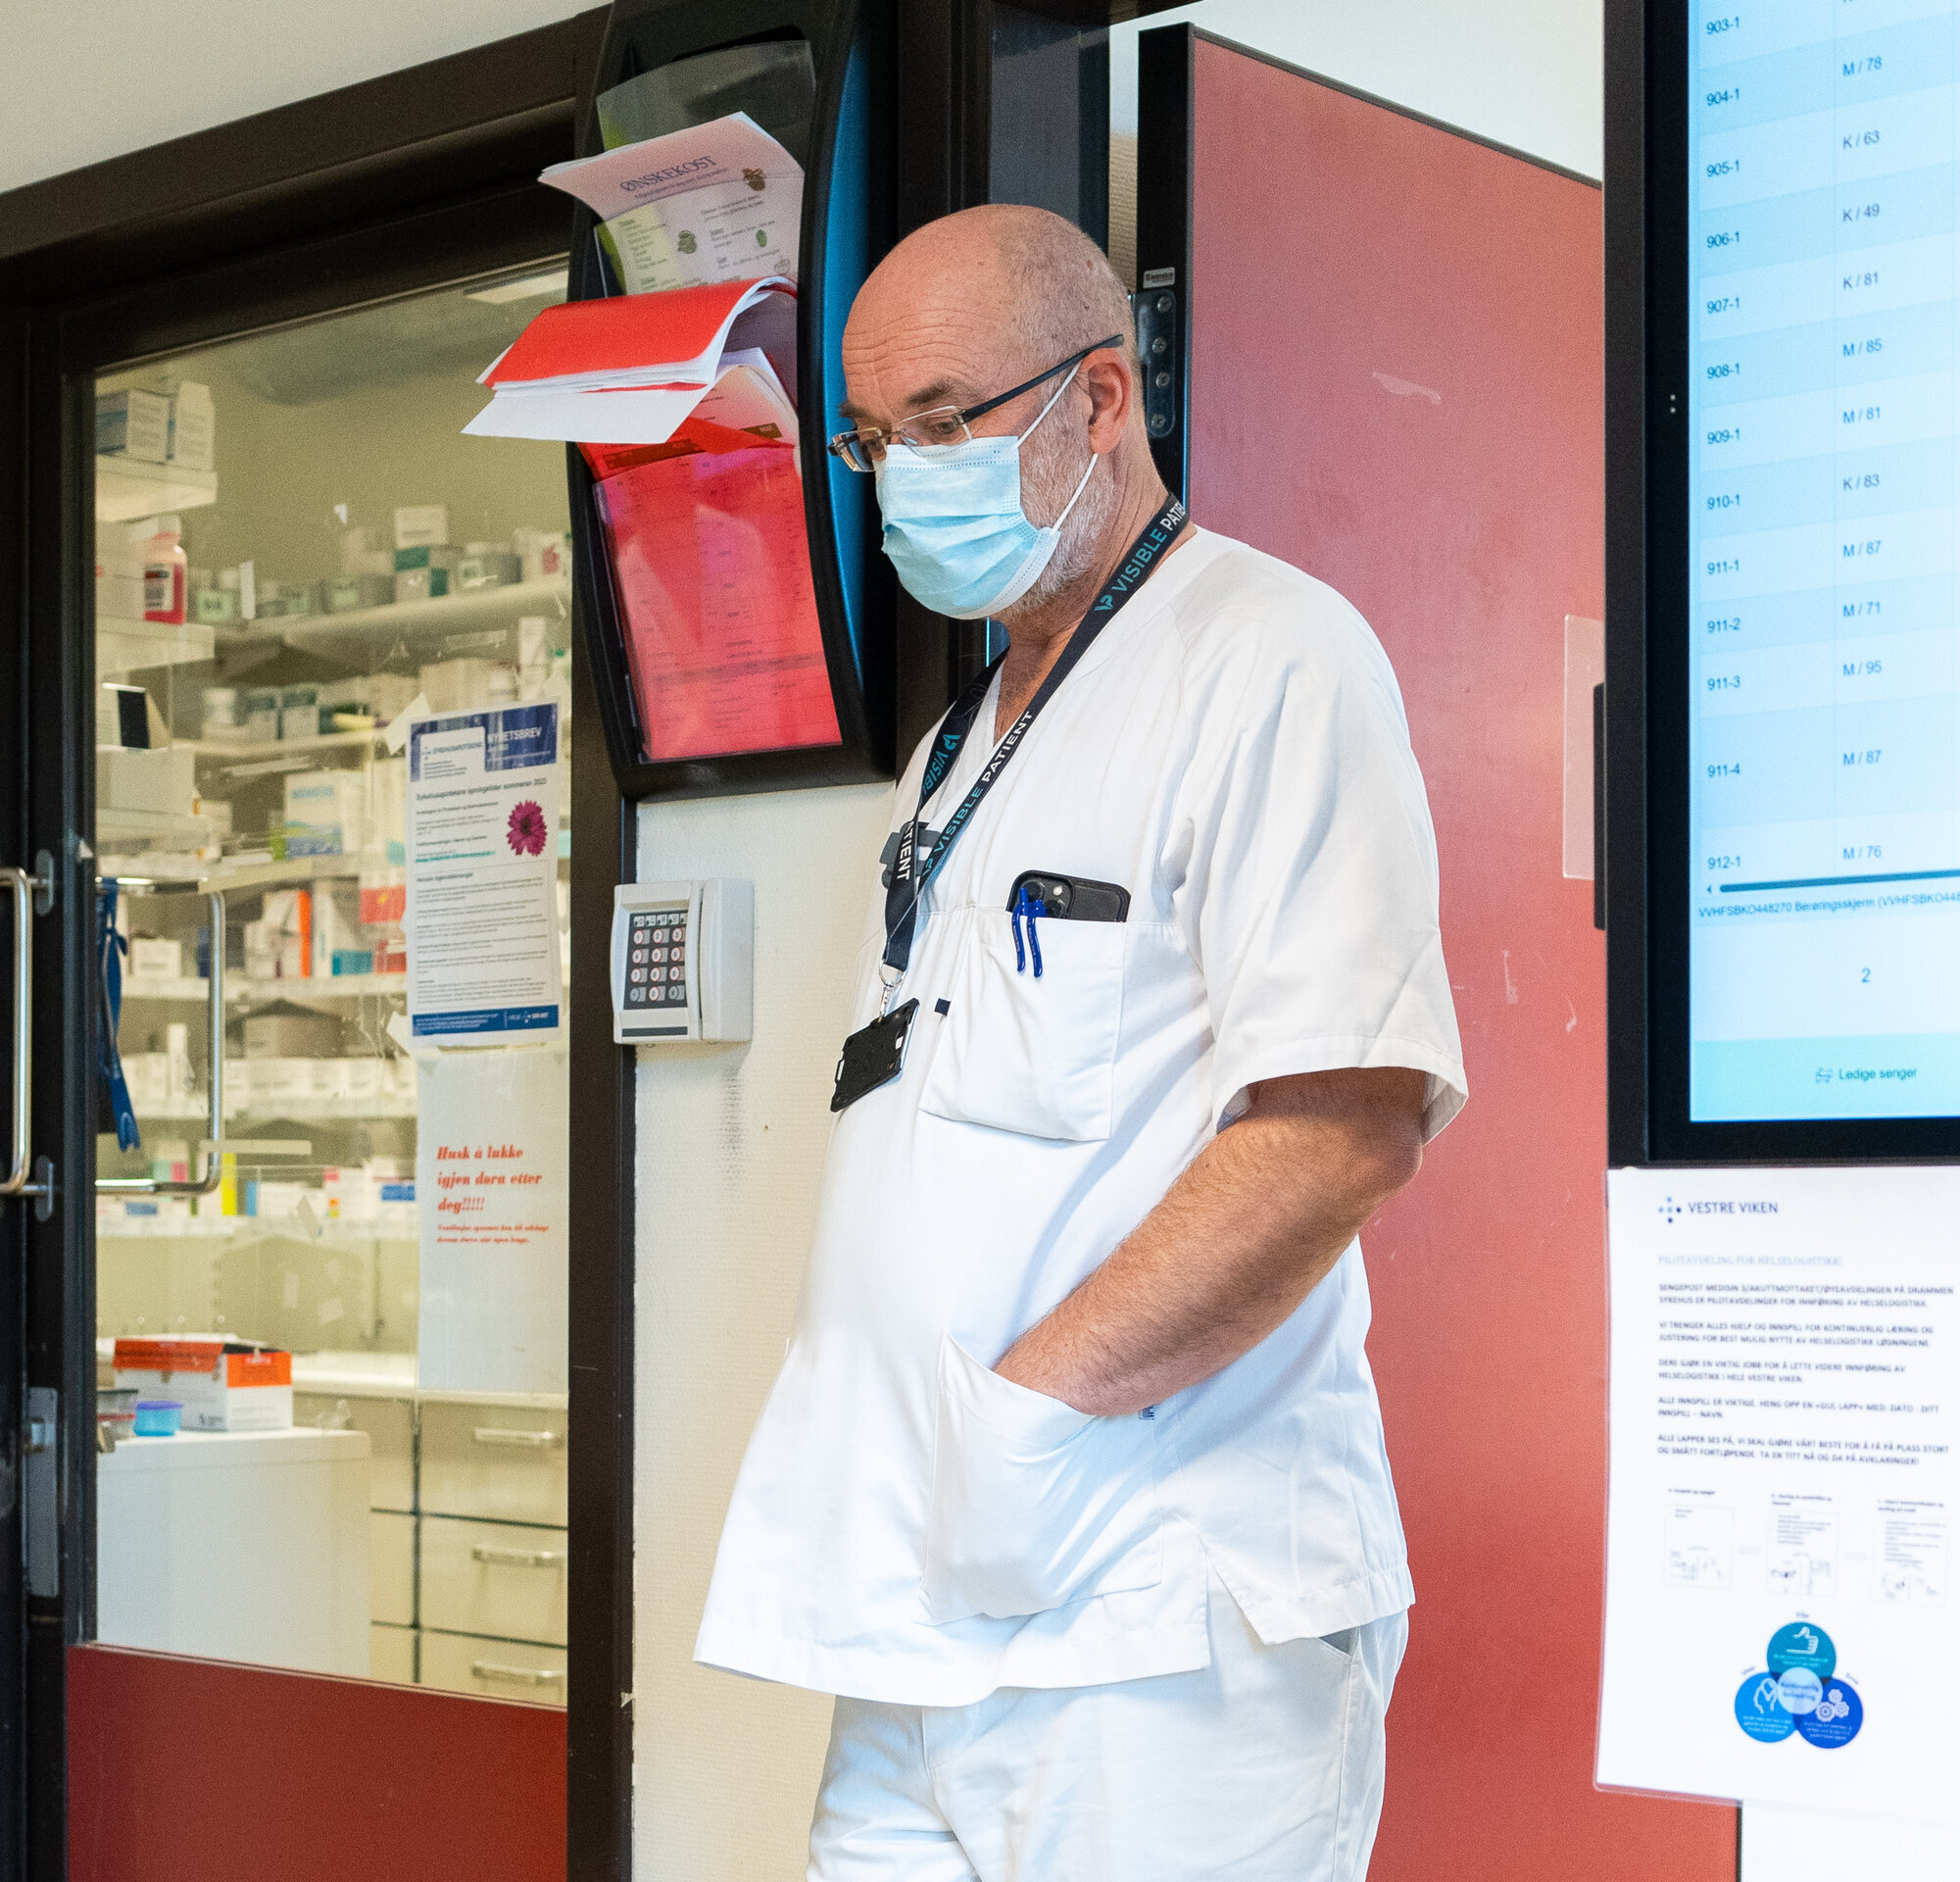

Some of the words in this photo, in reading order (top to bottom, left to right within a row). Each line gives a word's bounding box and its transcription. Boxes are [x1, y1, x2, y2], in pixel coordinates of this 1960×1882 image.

[1706, 17, 1739, 34] 903-1
[1843, 63, 1854, 75] M
[1868, 56, 1882, 71] 78
[1706, 88, 1739, 106] 904-1
[1843, 136, 1852, 149] K
[1863, 130, 1880, 145] 63
[619, 156, 717, 192] ØNSKEKOST
[1706, 160, 1739, 177] 905-1
[1842, 209, 1852, 222] K
[1864, 203, 1880, 217] 49
[1707, 231, 1740, 248] 906-1
[1843, 276, 1852, 289] K
[1864, 272, 1878, 286] 81
[1707, 298, 1740, 314] 907-1
[1843, 343, 1854, 356] M
[1866, 338, 1882, 353] 85
[1707, 364, 1740, 379] 908-1
[1843, 411, 1854, 422] M
[1866, 407, 1881, 421] 81
[1707, 428, 1740, 444] 909-1
[1843, 478, 1852, 490] K
[1864, 473, 1880, 488] 83
[1707, 494, 1740, 510] 910-1
[1843, 545, 1854, 557] M
[1866, 540, 1882, 555] 87
[1111, 528, 1167, 591] VISIBLE
[1707, 560, 1739, 575] 911-1
[1843, 604, 1854, 617] M
[1867, 602, 1881, 615] 71
[1707, 618, 1740, 633] 911-2
[1843, 664, 1854, 675] M
[1866, 661, 1882, 674] 95
[1707, 675, 1740, 691] 911-3
[1843, 753, 1854, 765] M
[1866, 750, 1882, 764] 87
[1707, 764, 1740, 777] 911-4
[934, 786, 984, 854] VISIBLE
[981, 711, 1032, 783] PATIENT
[1843, 848, 1854, 859] M
[1868, 845, 1882, 858] 76
[1707, 856, 1740, 869] 912-1
[1861, 967, 1871, 983] 2
[1838, 1067, 1877, 1082] Ledige
[1879, 1068, 1917, 1082] senger
[437, 1145, 470, 1161] Husk
[487, 1145, 523, 1160] lukke
[437, 1171, 470, 1190] igjen
[510, 1172, 543, 1185] etter
[1688, 1202, 1735, 1213] VESTRE
[1739, 1202, 1778, 1213] VIKEN
